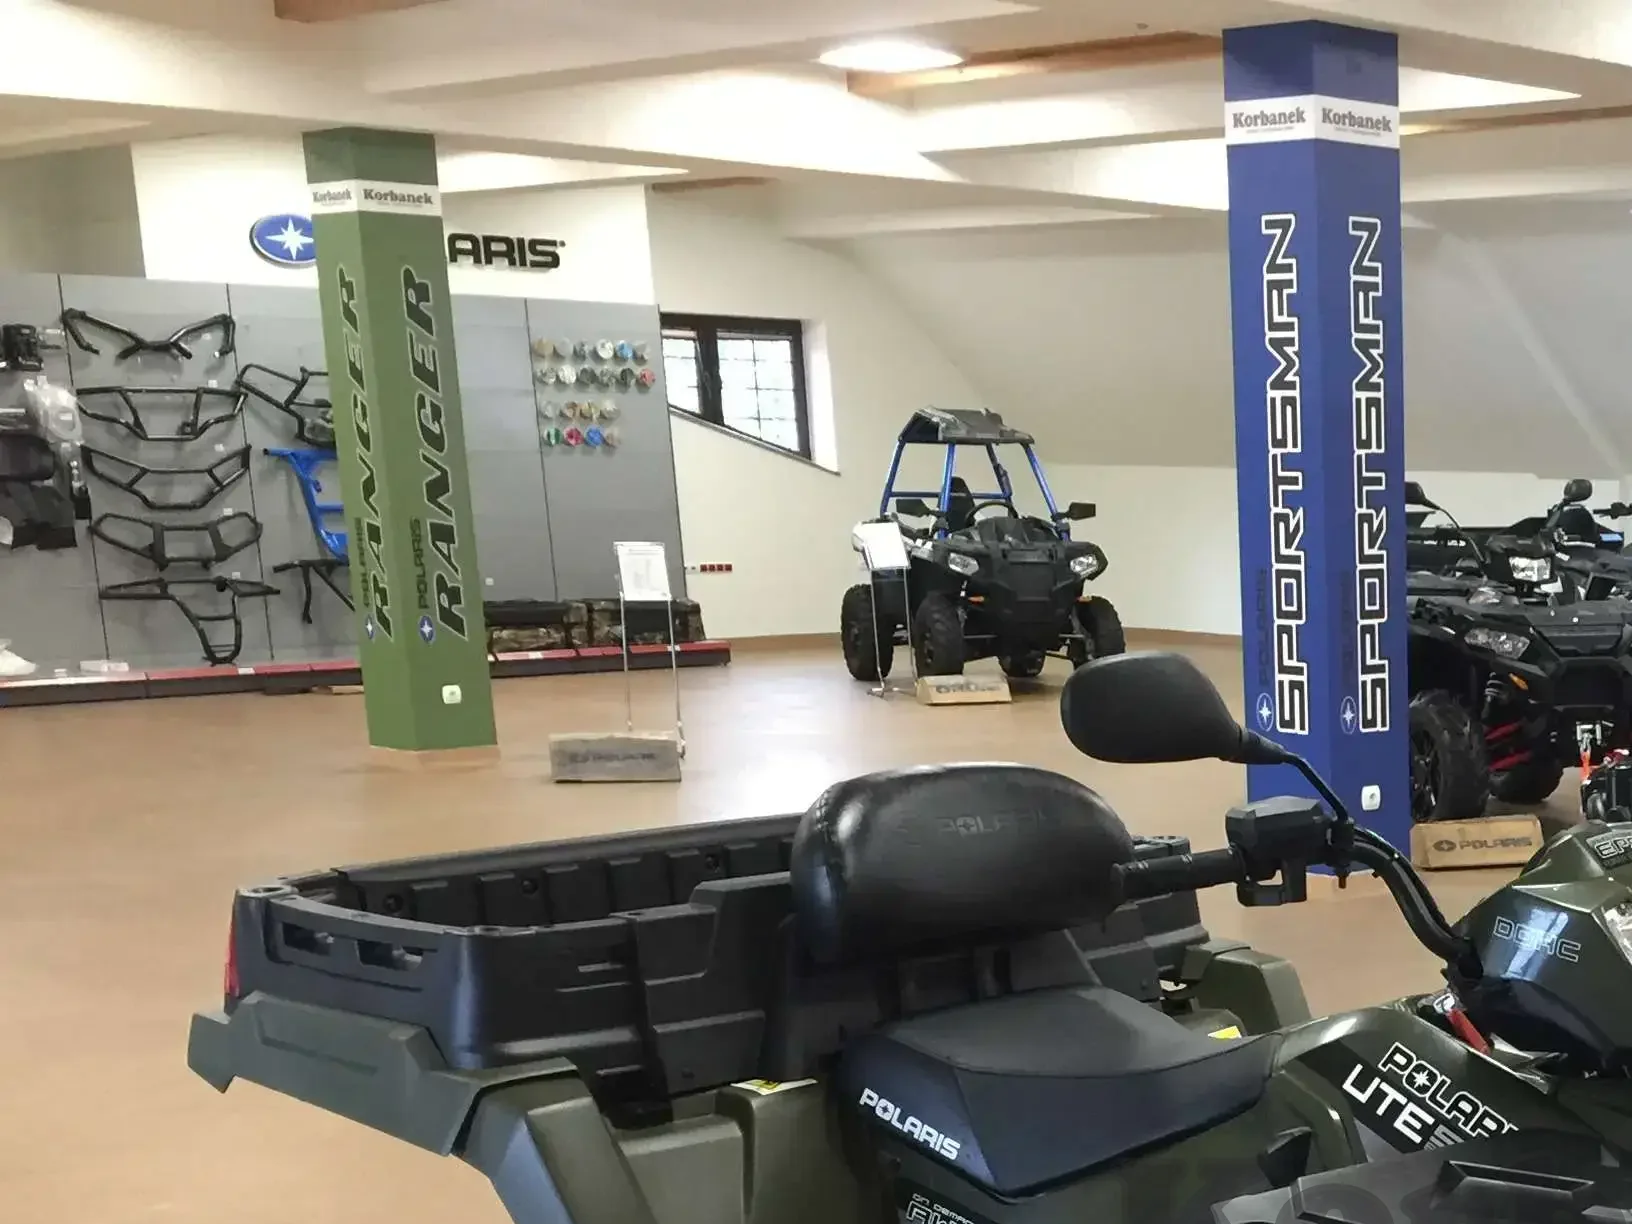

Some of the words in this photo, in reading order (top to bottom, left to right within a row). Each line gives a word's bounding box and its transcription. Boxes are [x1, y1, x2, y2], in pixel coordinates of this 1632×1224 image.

[1232, 106, 1306, 129] Korbanek
[1321, 107, 1393, 132] Korbanek
[362, 188, 433, 205] Korbanek
[447, 233, 566, 269] ARIS
[337, 263, 394, 643] RANGER
[401, 264, 469, 643] RANGER
[1261, 213, 1309, 735] SPORTSMAN
[1348, 215, 1390, 733] SPORTSMAN
[859, 1088, 961, 1160] POLARIS
[1378, 1042, 1519, 1137] POLAR
